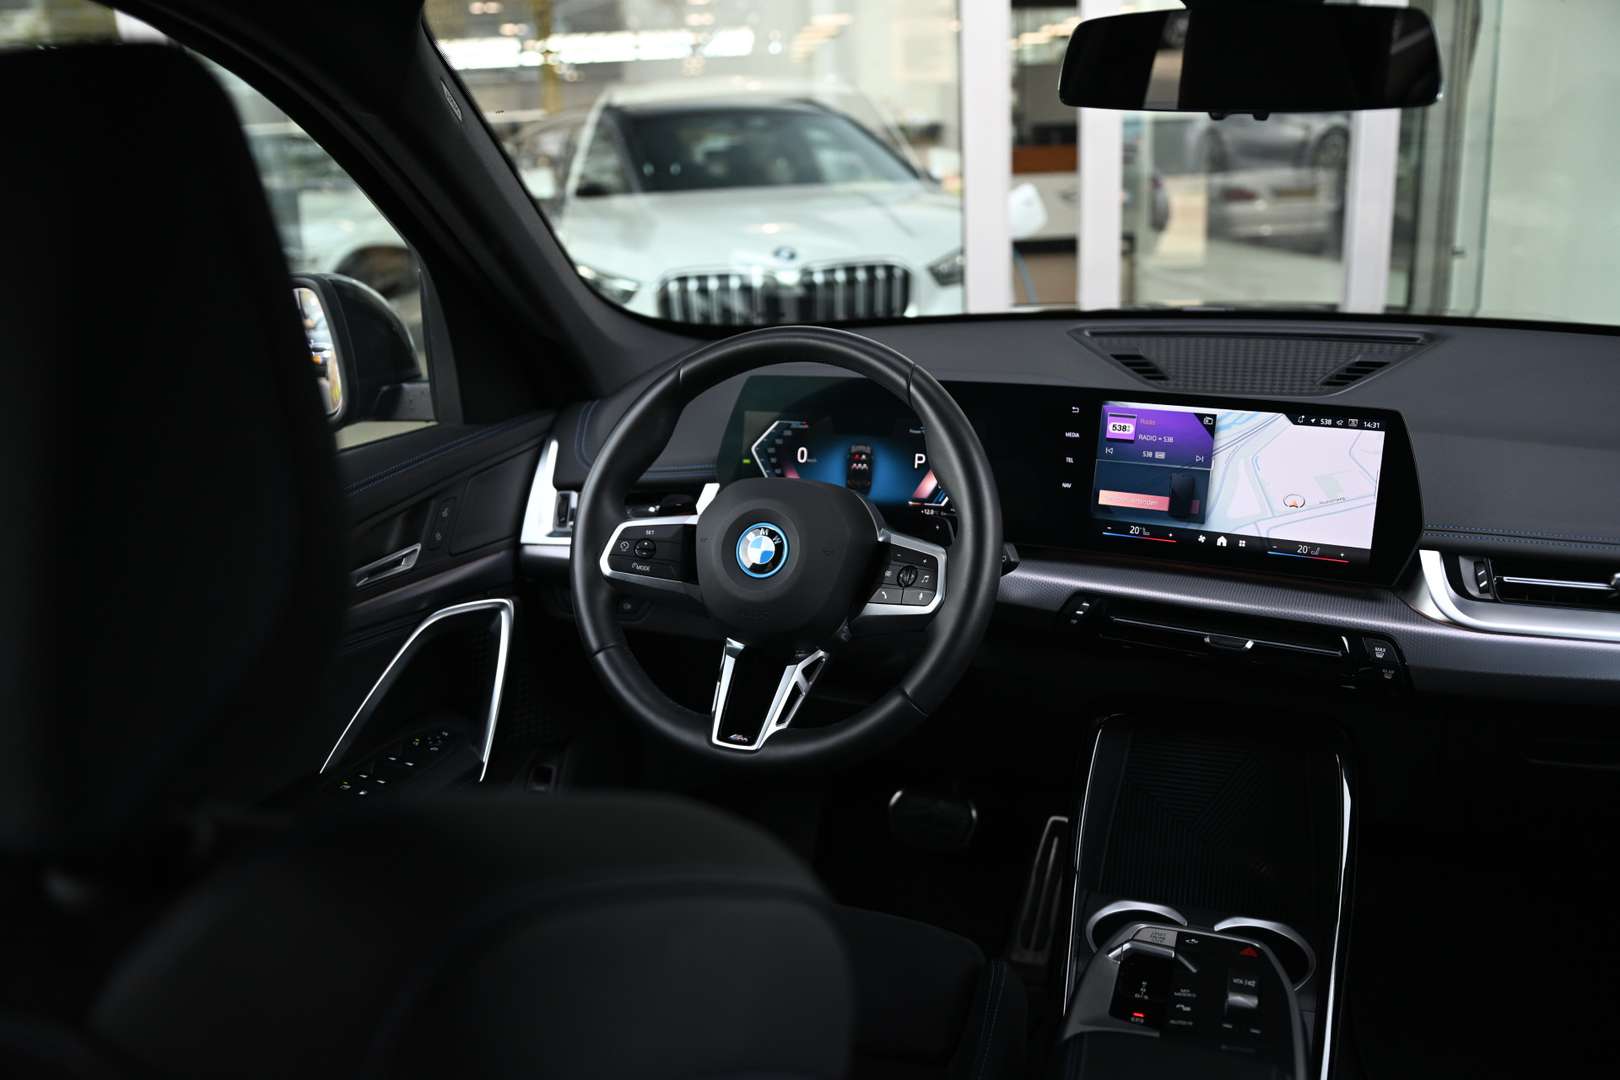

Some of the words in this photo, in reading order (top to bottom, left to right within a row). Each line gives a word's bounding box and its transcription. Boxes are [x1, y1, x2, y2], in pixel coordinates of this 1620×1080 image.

[1111, 423, 1127, 432] 538
[1363, 421, 1380, 429] 14:31
[1138, 434, 1157, 442] RADIO
[797, 446, 808, 463] 0
[914, 453, 926, 469] P
